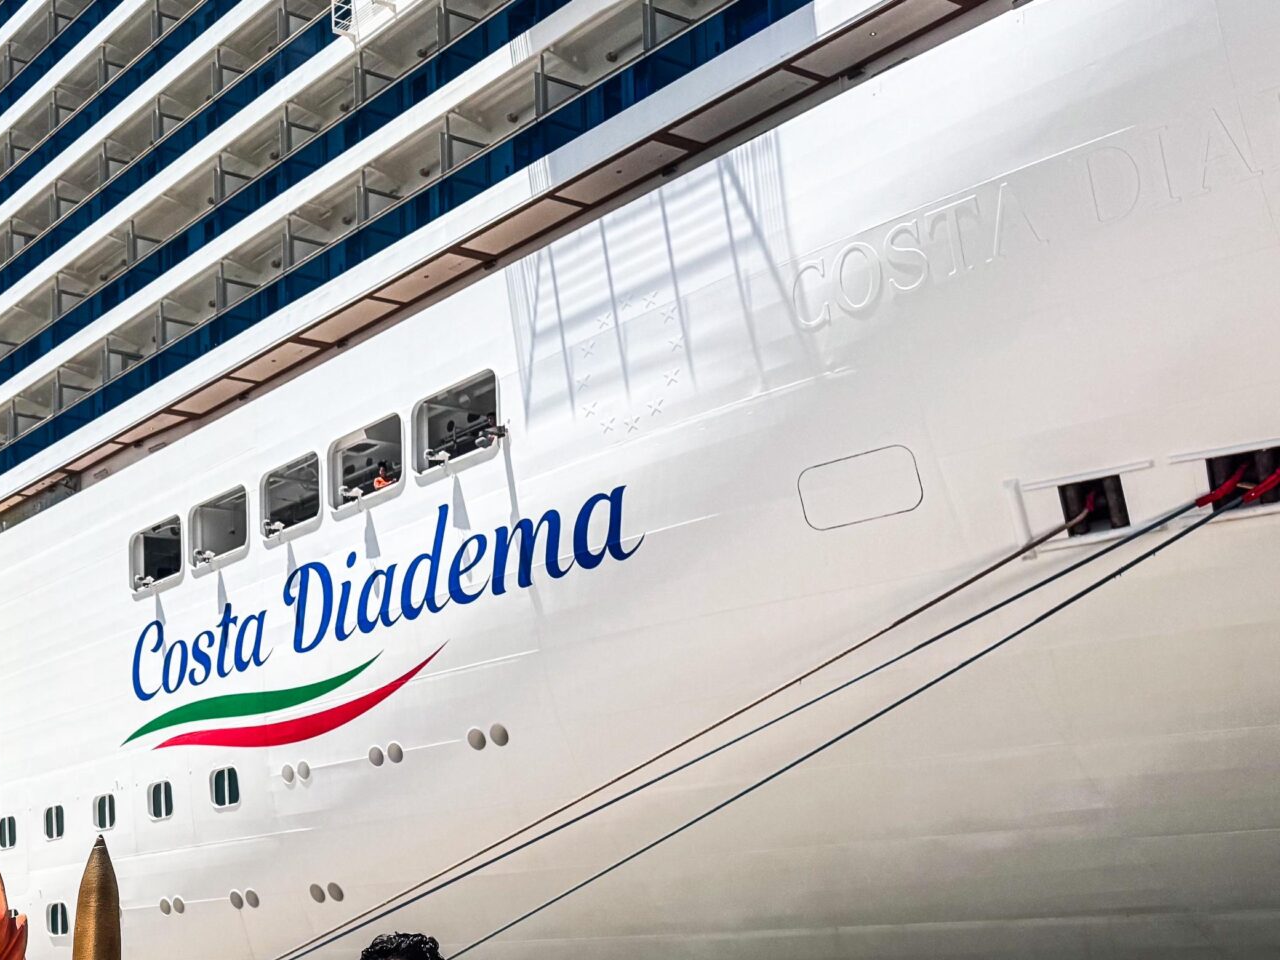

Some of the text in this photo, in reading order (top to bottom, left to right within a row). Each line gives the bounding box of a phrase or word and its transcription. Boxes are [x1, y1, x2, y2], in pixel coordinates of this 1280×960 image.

[792, 84, 1280, 332] COSTA DIA
[132, 485, 646, 701] Costa Diadema
